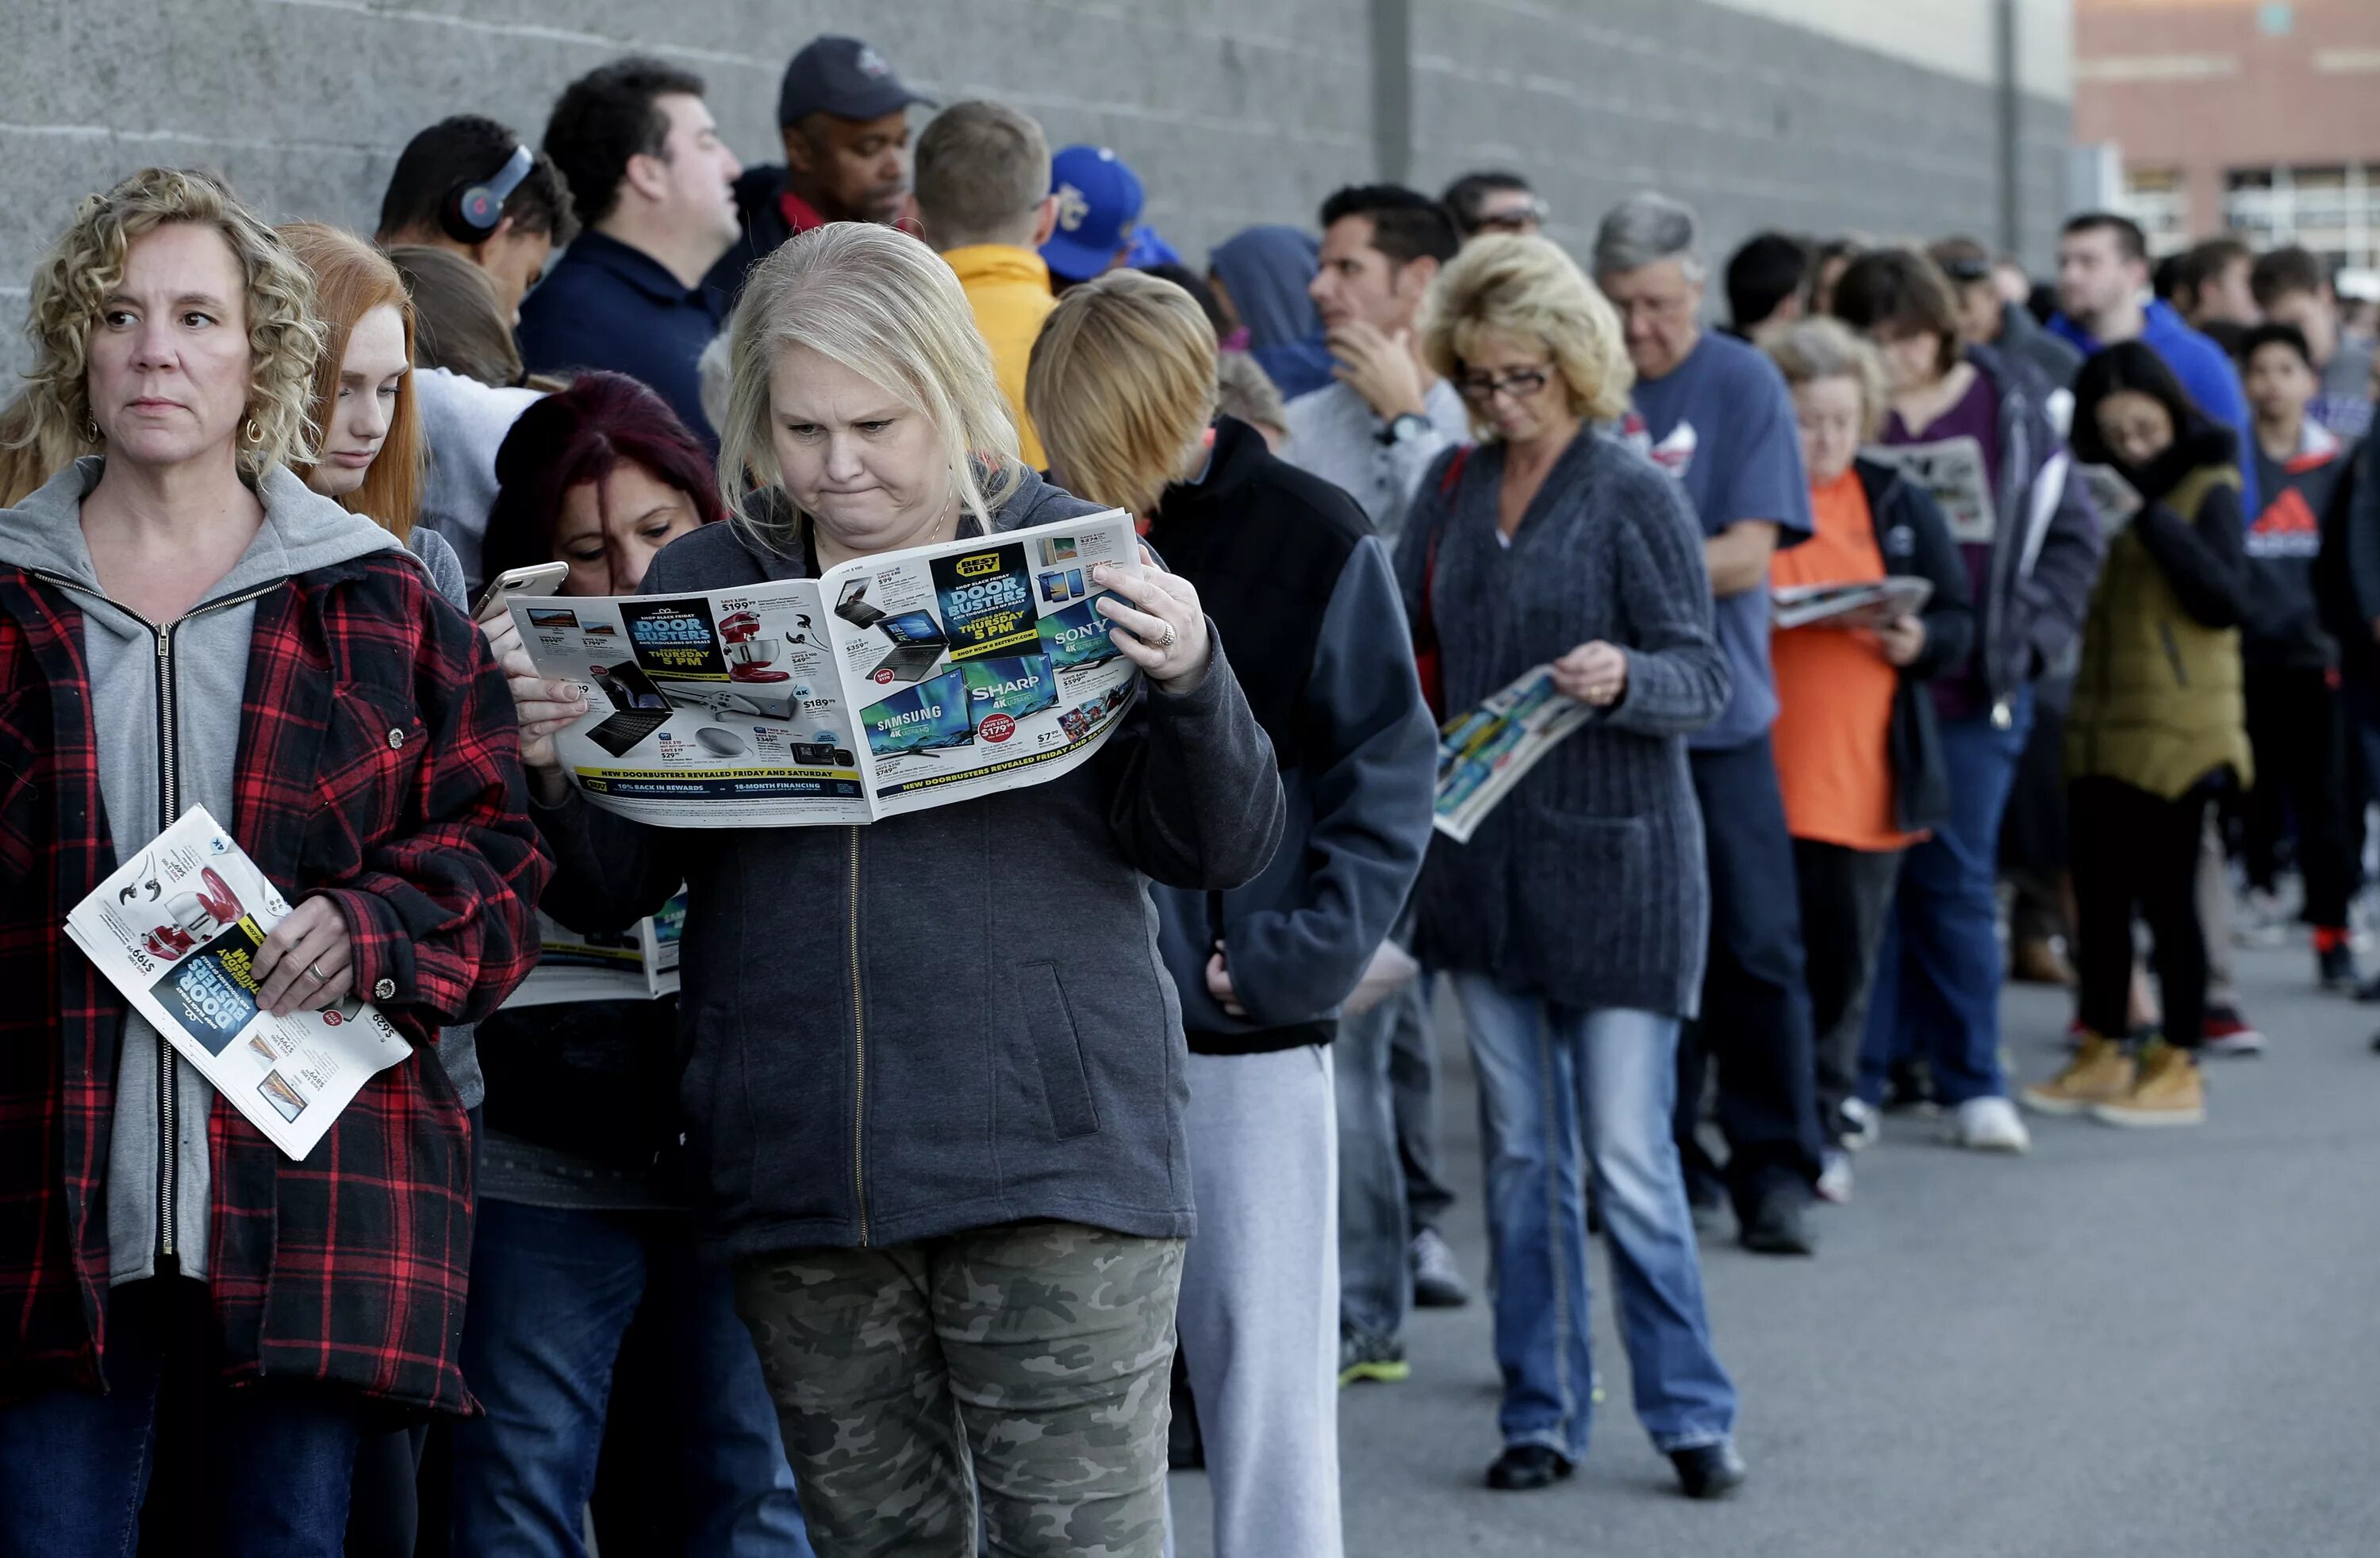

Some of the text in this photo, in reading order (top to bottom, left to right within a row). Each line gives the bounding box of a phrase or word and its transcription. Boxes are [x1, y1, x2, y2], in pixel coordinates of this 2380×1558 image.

[961, 556, 998, 567] BEST
[964, 563, 994, 574] BUY
[971, 578, 989, 586] BLACK
[950, 577, 1019, 604] DOOR
[722, 602, 749, 612] $199
[947, 587, 1027, 617] BUSTERS
[965, 606, 999, 617] THOUSANDS
[636, 618, 703, 631] DOOR
[958, 610, 1025, 634] THURSDAY
[635, 629, 711, 641] BUSTERS
[974, 621, 1015, 640] 5 PM
[1054, 618, 1109, 645] SONY
[994, 632, 1034, 647] BESTBUY.COM
[846, 643, 864, 652] $359
[1065, 644, 1077, 653] 4K
[972, 676, 1039, 701] SHARP
[804, 699, 829, 708] $189
[992, 700, 1007, 709] 4K
[877, 705, 942, 731] SAMSUNG
[890, 729, 901, 739] 4K
[981, 725, 1007, 737] $179
[1037, 732, 1051, 743] $7
[902, 781, 923, 791] NEW
[925, 767, 989, 787] DOORBUSTERS
[991, 757, 1035, 772] REVEALED
[1036, 747, 1068, 761] FRIDAY
[1069, 739, 1087, 751] AND
[876, 768, 892, 777] $749
[213, 838, 224, 850] 4K
[174, 864, 186, 877] $49
[132, 948, 155, 972] $199
[201, 956, 213, 969] DEALS
[232, 947, 252, 970] PM
[217, 949, 259, 993] THURSDAY
[221, 960, 232, 973] OPEN
[187, 957, 247, 1021] BUSTERS
[217, 974, 240, 1000] THOUSANDS
[178, 971, 232, 1028] DOOR
[240, 1000, 250, 1009] AND
[176, 987, 217, 1029] SHOP BLACK FRIDAY
[371, 1012, 394, 1038] $629
[279, 1037, 294, 1053] $799
[309, 1071, 324, 1088] $899
